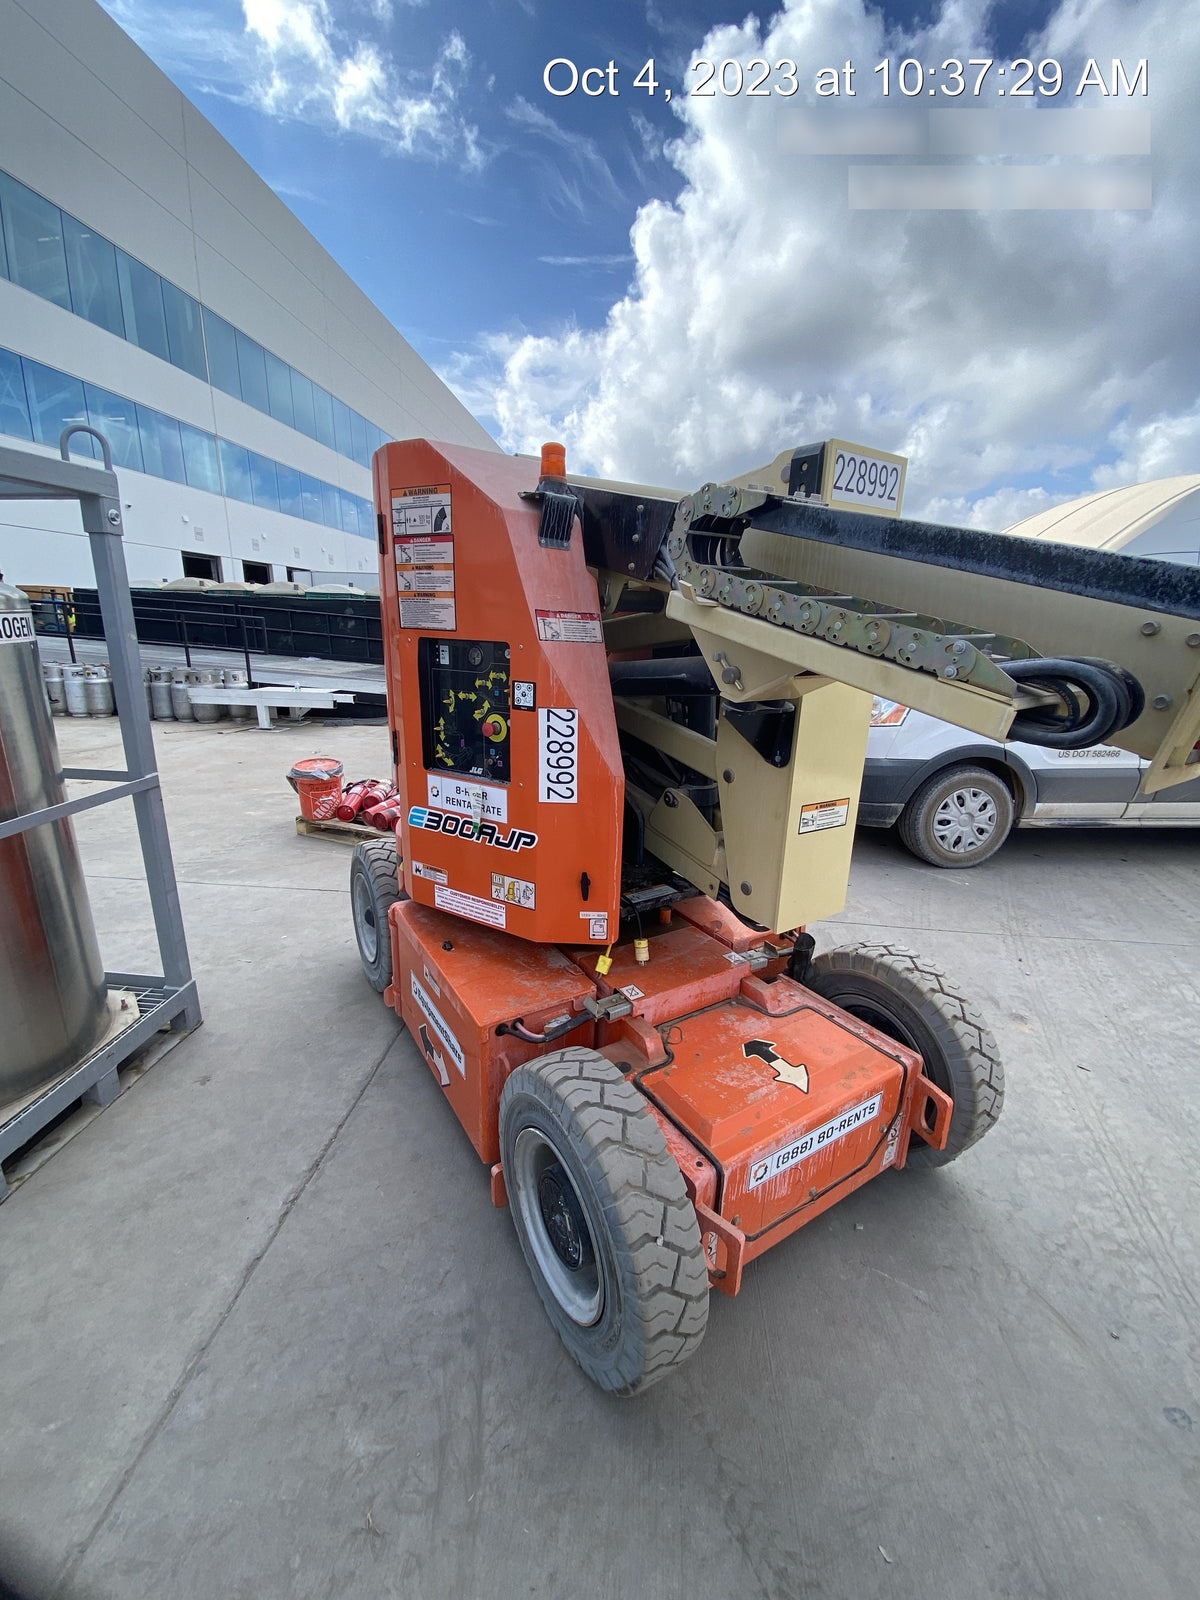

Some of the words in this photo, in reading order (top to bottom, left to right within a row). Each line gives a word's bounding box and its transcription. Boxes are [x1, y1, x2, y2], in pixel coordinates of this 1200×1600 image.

[833, 454, 899, 501] 228992
[409, 487, 438, 497] WARNING
[0, 616, 33, 639] OGEN
[546, 708, 576, 800] 228992
[1058, 750, 1071, 758] US
[1072, 750, 1091, 758] DOT
[1092, 750, 1121, 758] 582466
[469, 766, 484, 775] JLG
[455, 786, 488, 800] 8-HR
[445, 796, 473, 810] RENTA
[480, 804, 502, 816] RATE
[408, 806, 538, 852] E300AJP
[450, 890, 471, 900] CUSTOMER
[776, 1140, 814, 1169] (888)
[817, 1102, 877, 1145] 80-RENTS
